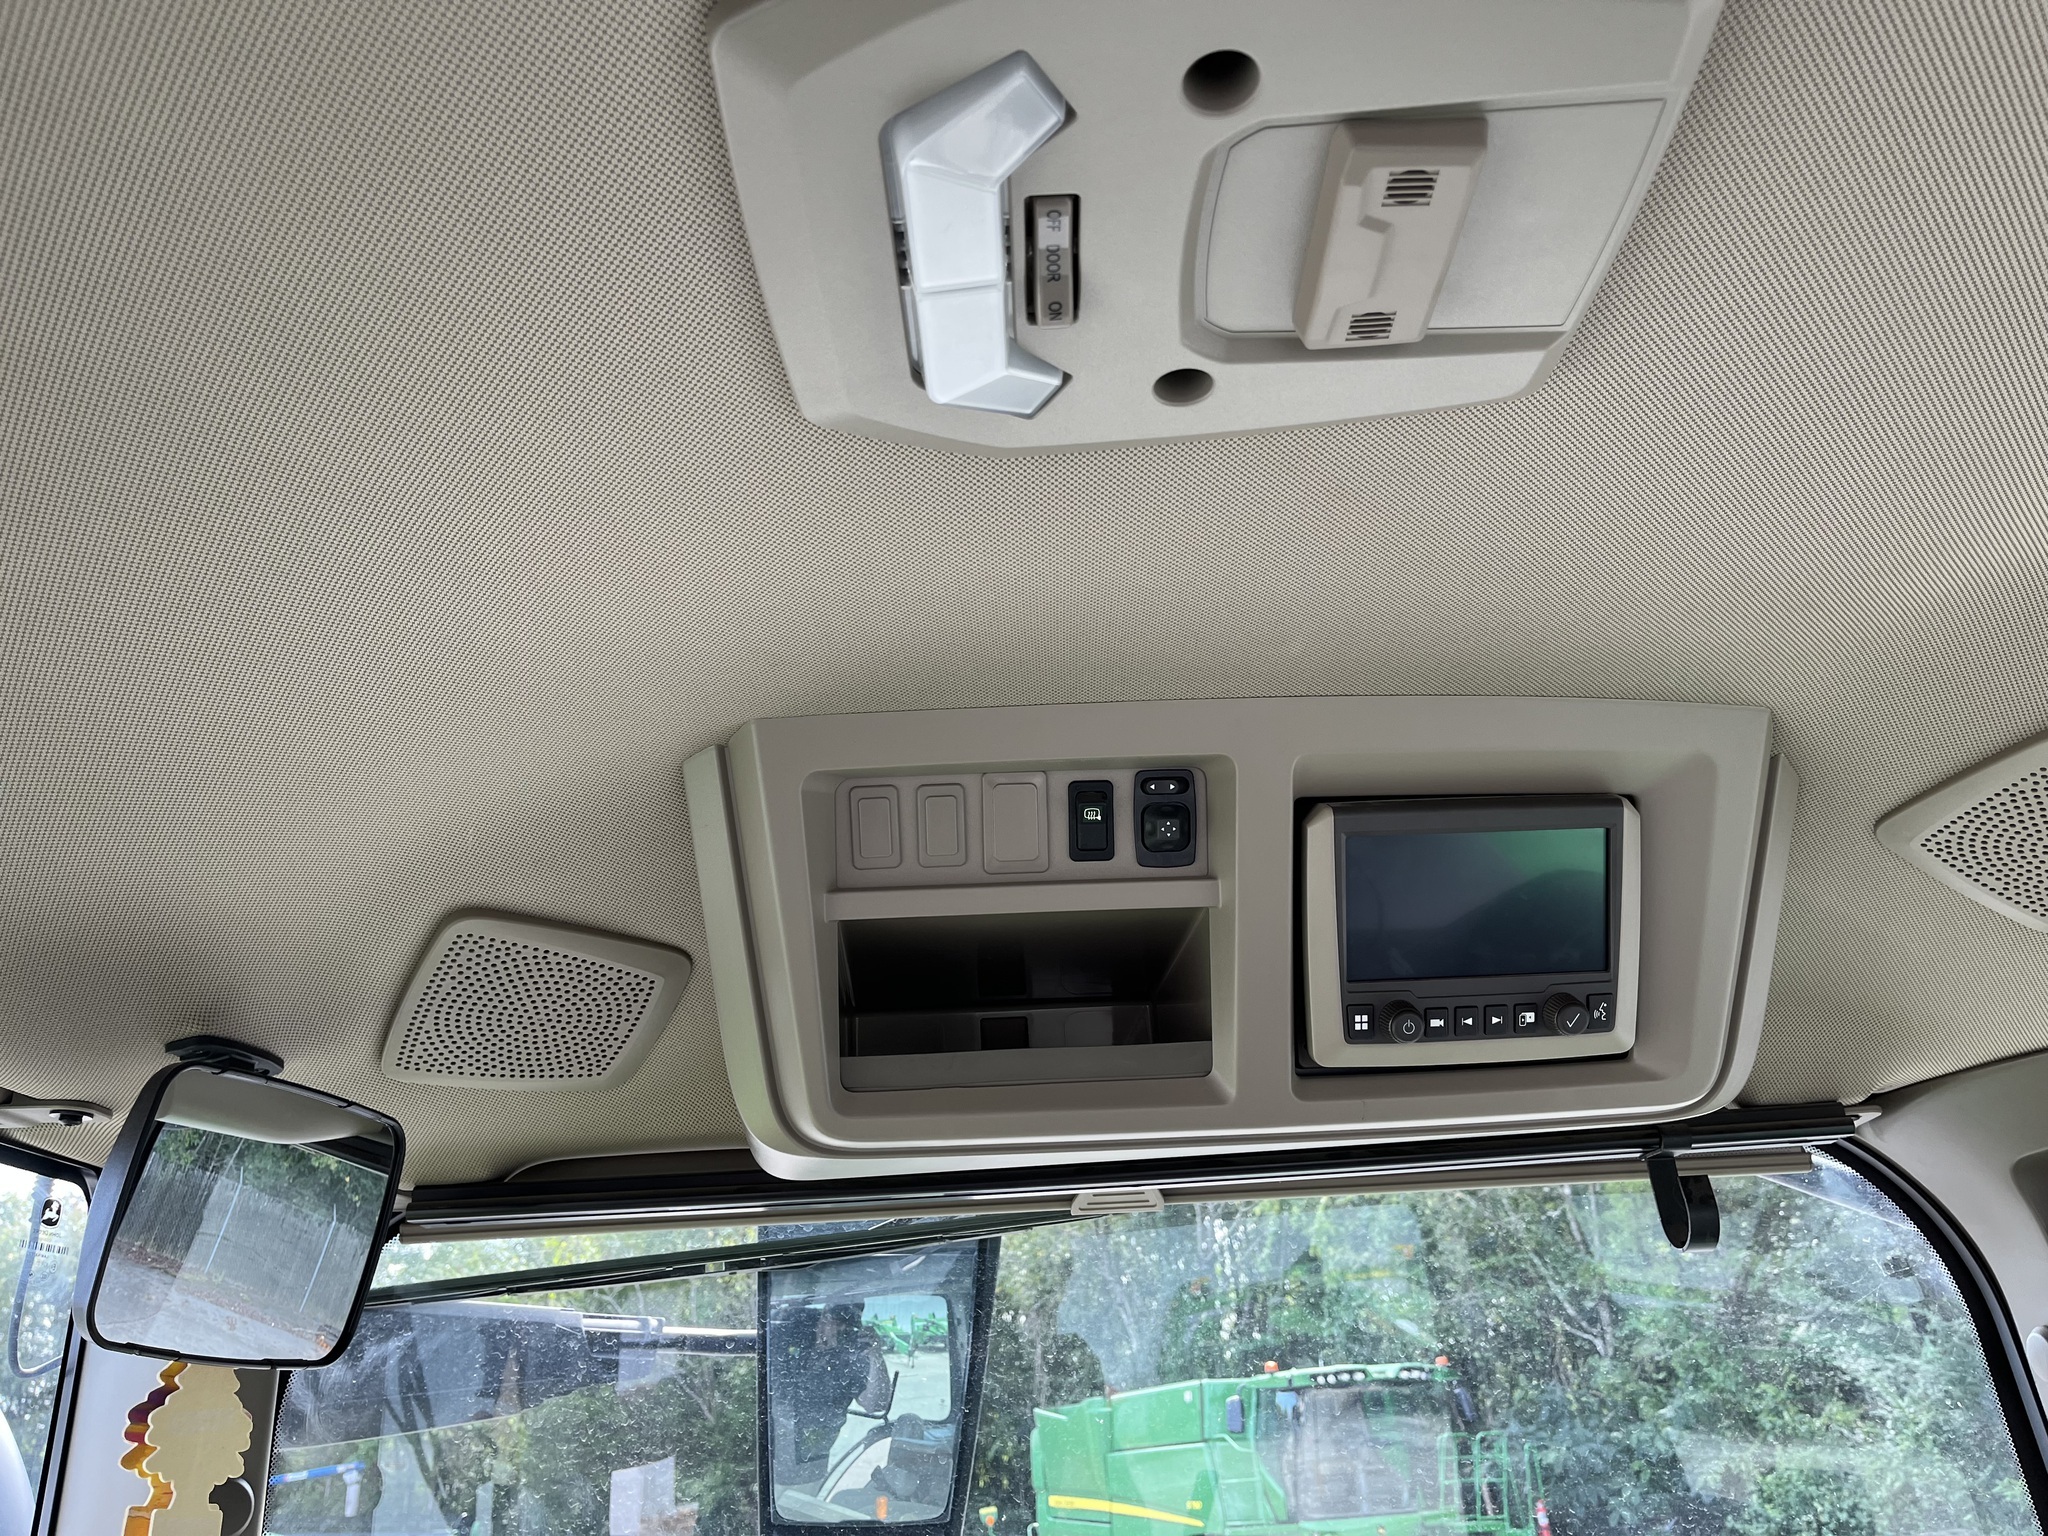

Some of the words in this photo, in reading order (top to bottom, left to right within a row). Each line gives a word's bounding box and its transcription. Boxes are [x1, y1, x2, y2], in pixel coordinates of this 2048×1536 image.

[1046, 209, 1062, 232] OFF
[1046, 244, 1061, 283] DOOR
[1048, 301, 1063, 321] ON
